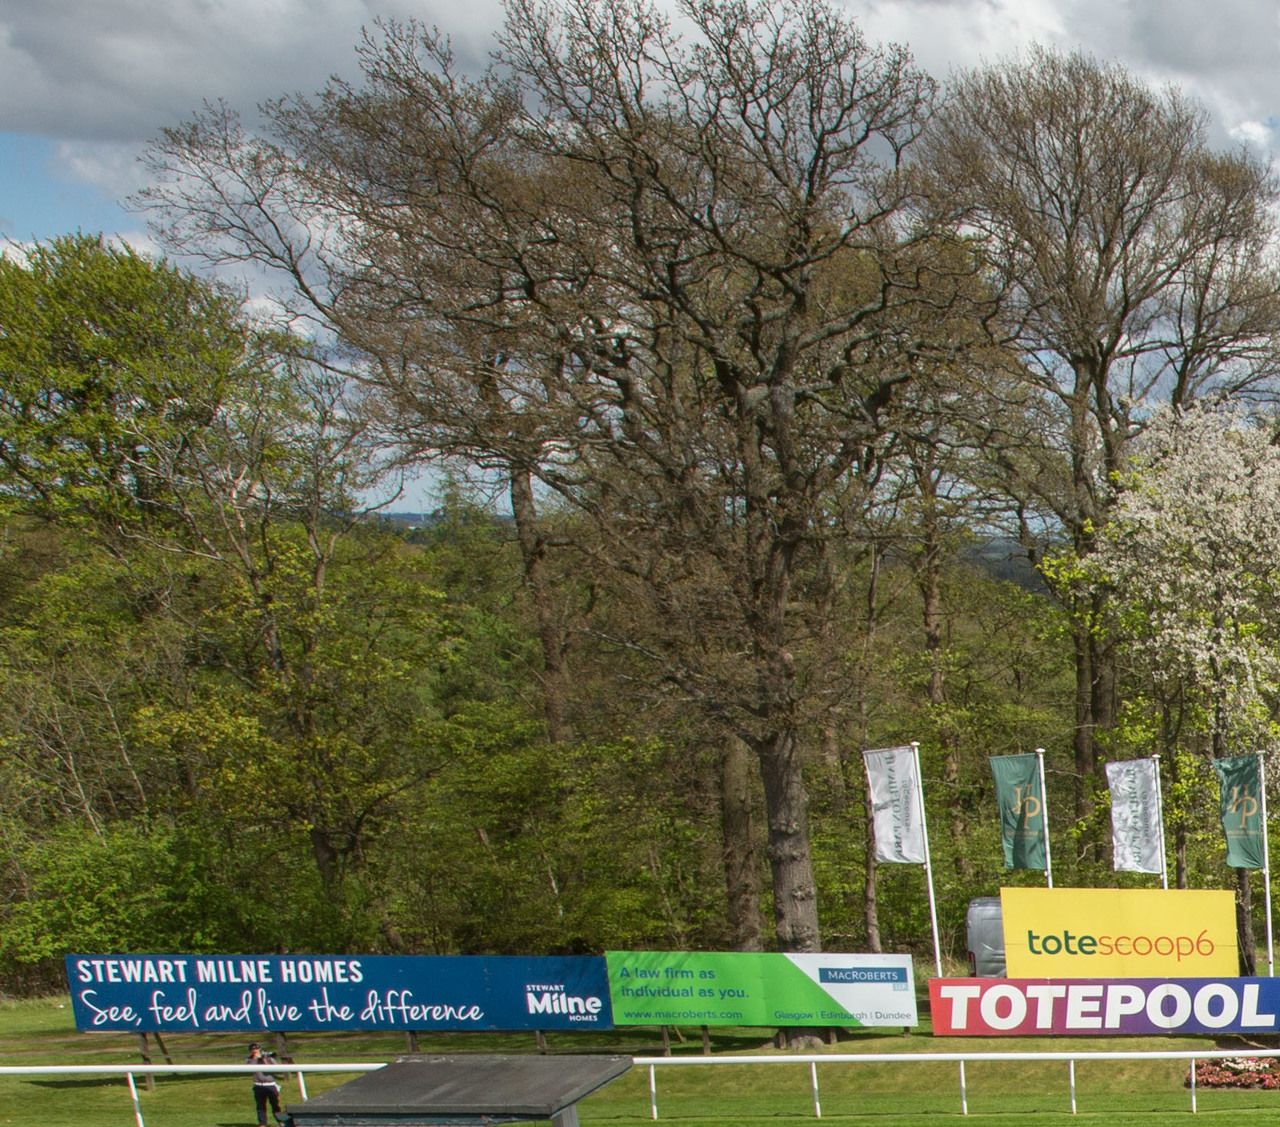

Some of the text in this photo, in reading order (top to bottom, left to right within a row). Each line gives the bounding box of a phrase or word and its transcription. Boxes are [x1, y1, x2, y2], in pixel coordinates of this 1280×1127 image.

[1028, 929, 1214, 962] totescoop6
[77, 960, 363, 984] STEWART MILNE HOMES
[620, 967, 716, 979] A law firm as
[526, 992, 602, 1015] Milne
[621, 985, 749, 1000] individual as you.
[81, 986, 484, 1027] See, feel and live the difference
[623, 1010, 743, 1020] www.macroberts.com
[774, 1010, 912, 1021] Glasgow Edinburgh Dundee
[940, 983, 1276, 1030] TOTEPOOL
